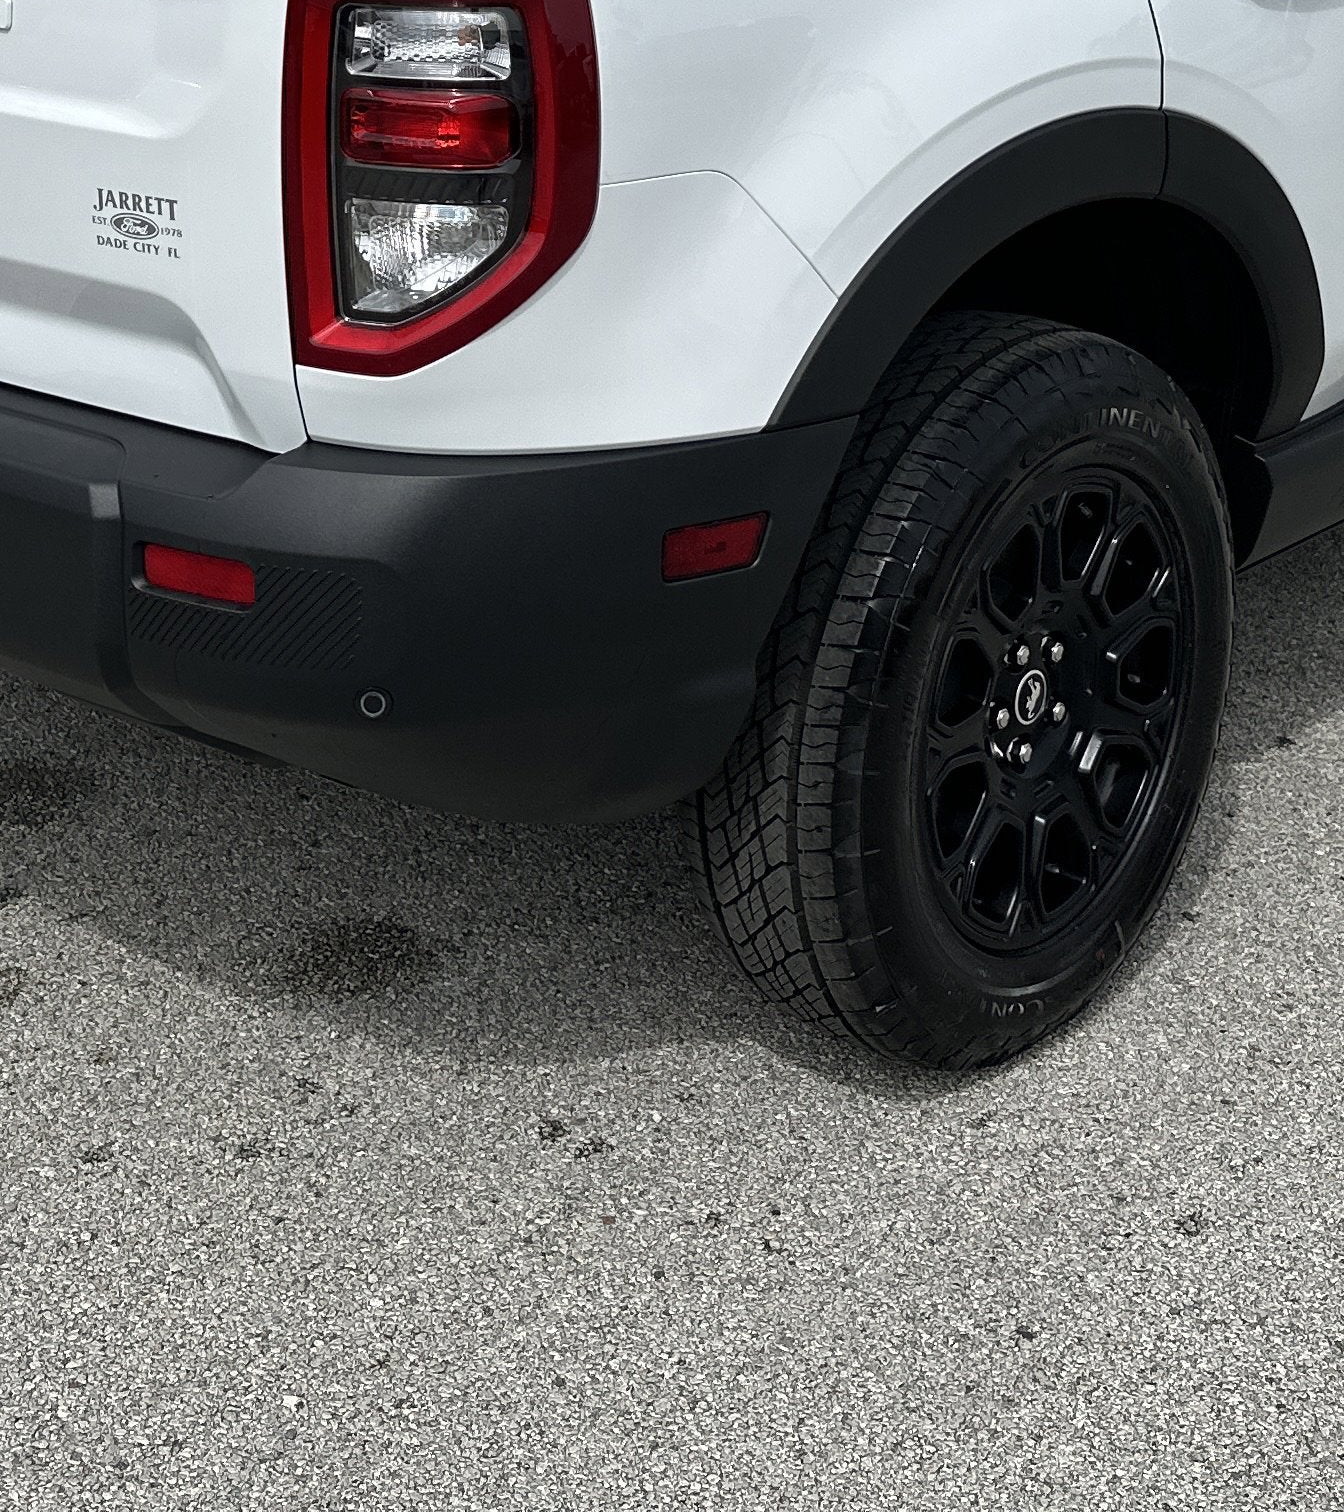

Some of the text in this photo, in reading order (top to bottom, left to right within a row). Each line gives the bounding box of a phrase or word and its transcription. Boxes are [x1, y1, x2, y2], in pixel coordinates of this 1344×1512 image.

[93, 187, 178, 221] JARRETT
[120, 217, 149, 235] Ford
[160, 227, 183, 238] 1978
[96, 235, 181, 259] DADE CITY FL
